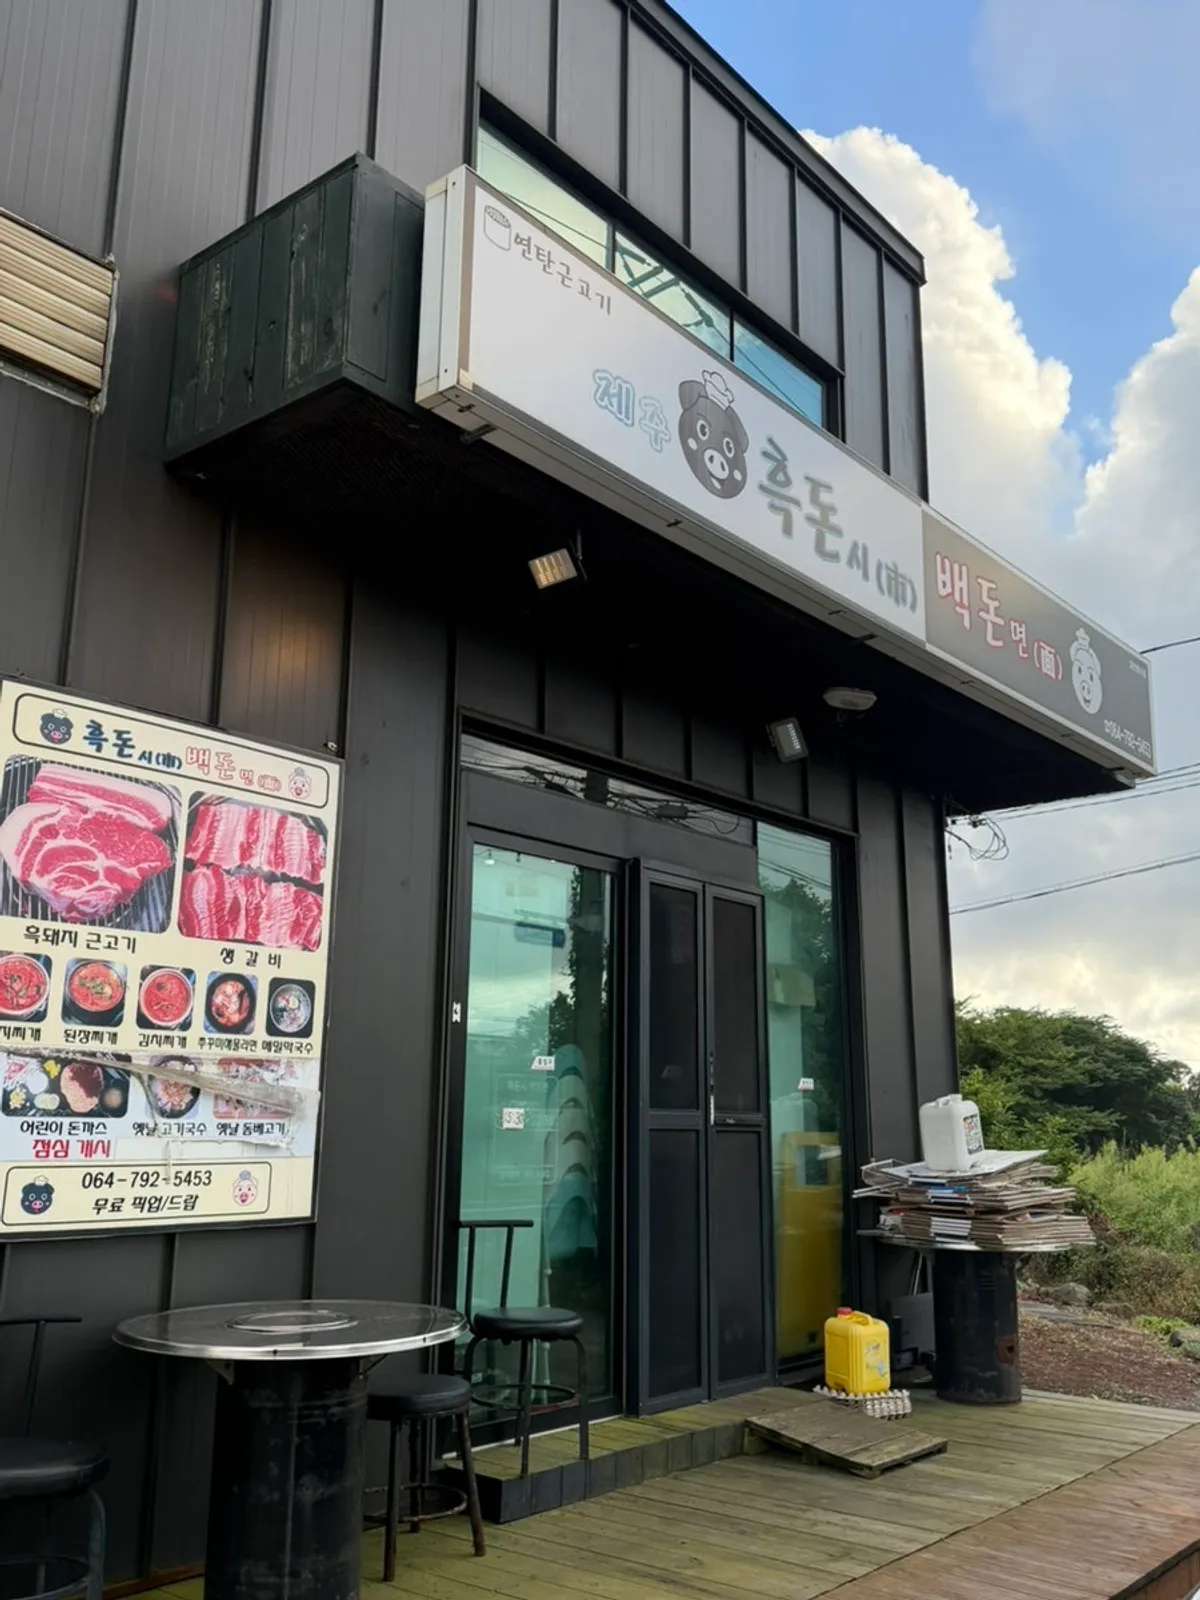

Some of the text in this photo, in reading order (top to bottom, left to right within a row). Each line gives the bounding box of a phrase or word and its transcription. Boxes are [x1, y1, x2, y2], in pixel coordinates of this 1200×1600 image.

[513, 231, 612, 316] 연탄근고기
[592, 368, 672, 454] 제주
[23, 924, 137, 954] 흑돼지 근고기
[63, 1028, 119, 1046] 된장찌개
[138, 1033, 188, 1049] 김치찌개
[20, 1120, 108, 1136] 어린이 돈까스
[132, 1121, 207, 1137] 옛날 고기국수
[216, 1122, 286, 1136] 옛날 돔베고기
[32, 1138, 111, 1159] 점심 개시
[81, 1170, 213, 1190] 064-792-5453
[92, 1197, 126, 1216] 무료
